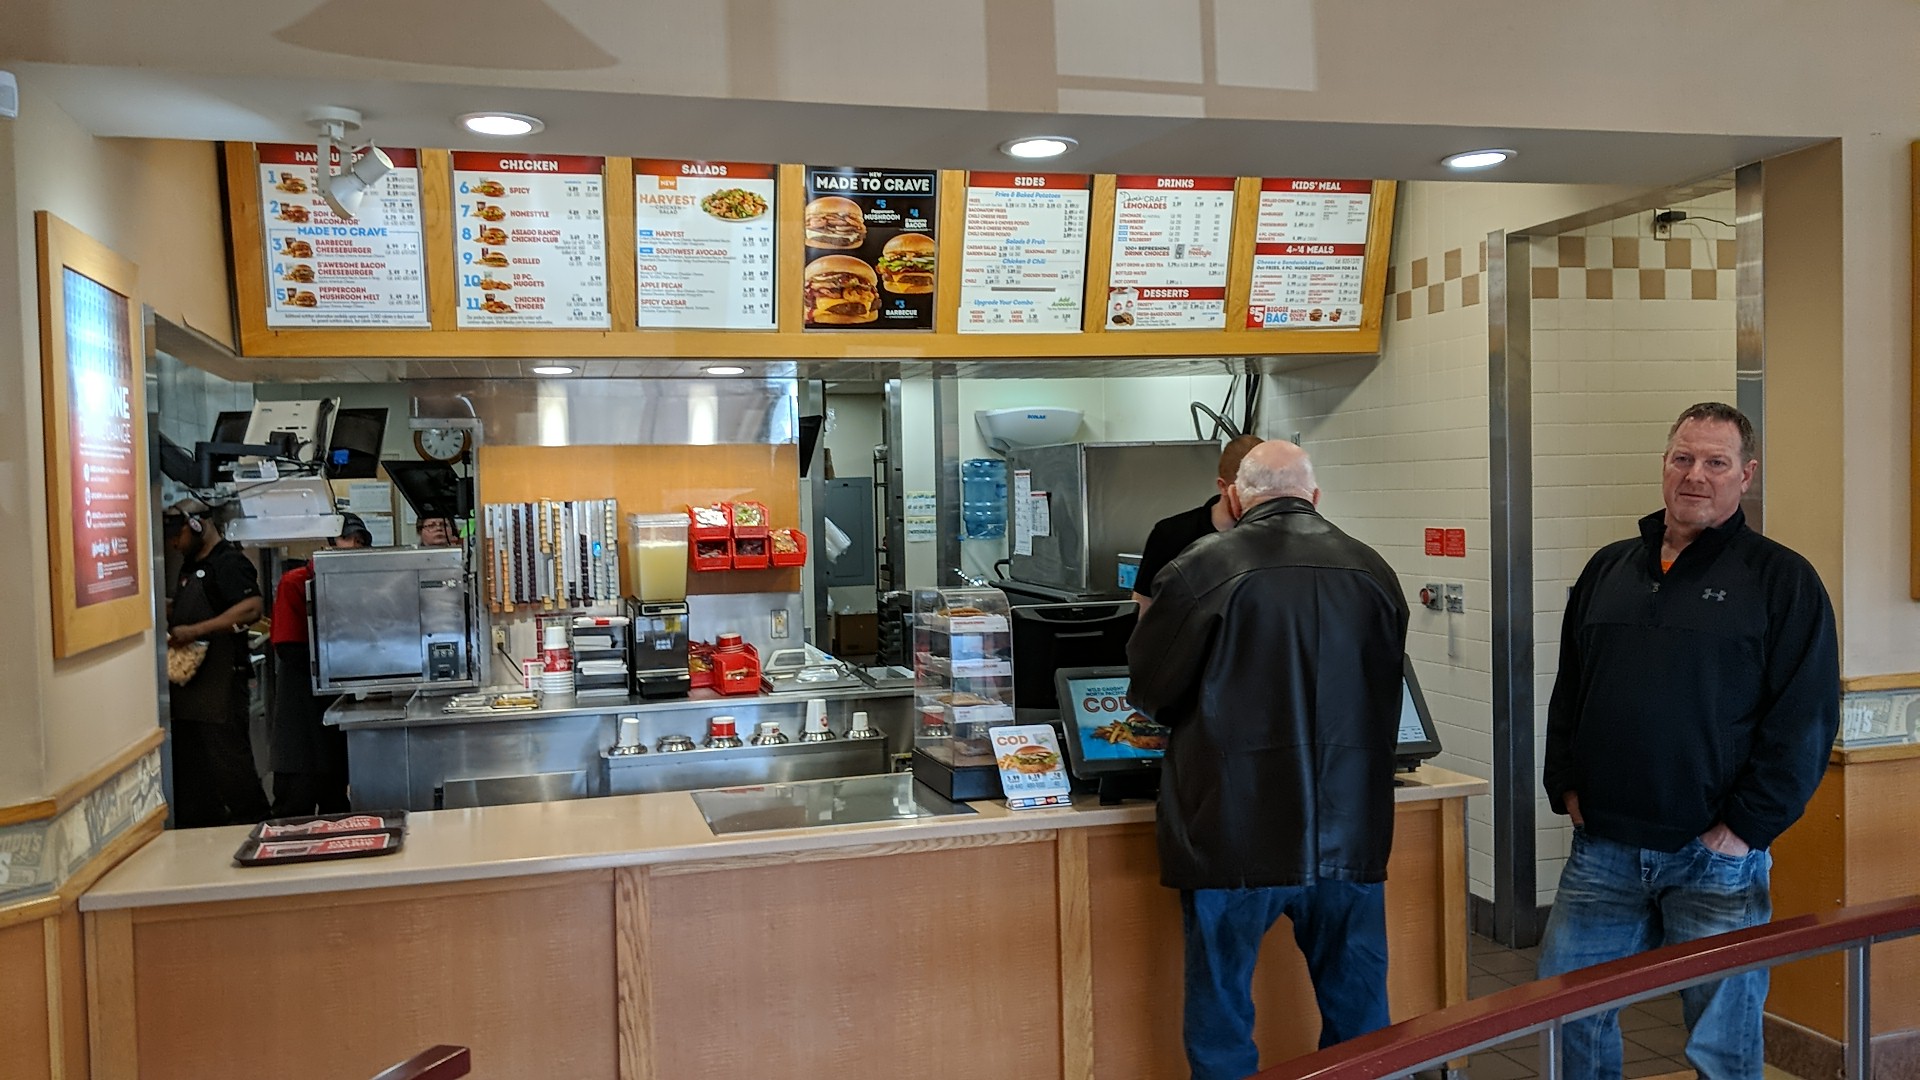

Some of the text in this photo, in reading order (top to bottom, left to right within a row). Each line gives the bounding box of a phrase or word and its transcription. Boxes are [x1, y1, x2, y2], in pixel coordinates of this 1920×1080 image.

[500, 159, 559, 171] CHICKEN
[682, 164, 728, 176] SALADS
[268, 170, 277, 184] 1
[1014, 177, 1045, 186] SIDES
[459, 181, 470, 194] 6
[816, 176, 930, 191] MADE TO CRAVE
[1157, 179, 1194, 188] DRINKS
[1292, 180, 1341, 190] KIDS' MEAL
[640, 194, 696, 206] HARVEST
[270, 201, 280, 214] 2
[460, 204, 470, 218] 7
[510, 210, 550, 218] HOMESTYLE
[298, 226, 388, 236] MADE TO CRAVE
[462, 228, 472, 240] 8
[272, 238, 283, 250] 3
[316, 239, 353, 247] BARBECUE
[316, 246, 372, 254] CHEESEBURGER
[1306, 246, 1334, 254] MEALS
[463, 252, 472, 264] 9
[274, 263, 284, 275] 4
[360, 262, 386, 270] BACON
[640, 264, 658, 272] TACO
[464, 275, 481, 288] 10
[514, 280, 545, 288] NUGGETS
[276, 288, 286, 300] 5
[319, 286, 366, 294] PEPPERCORN
[1143, 290, 1190, 298] DESSERTS
[466, 298, 480, 310] 11
[1250, 306, 1264, 322] $5
[1266, 313, 1288, 322] BAG
[997, 736, 1028, 746] COD
